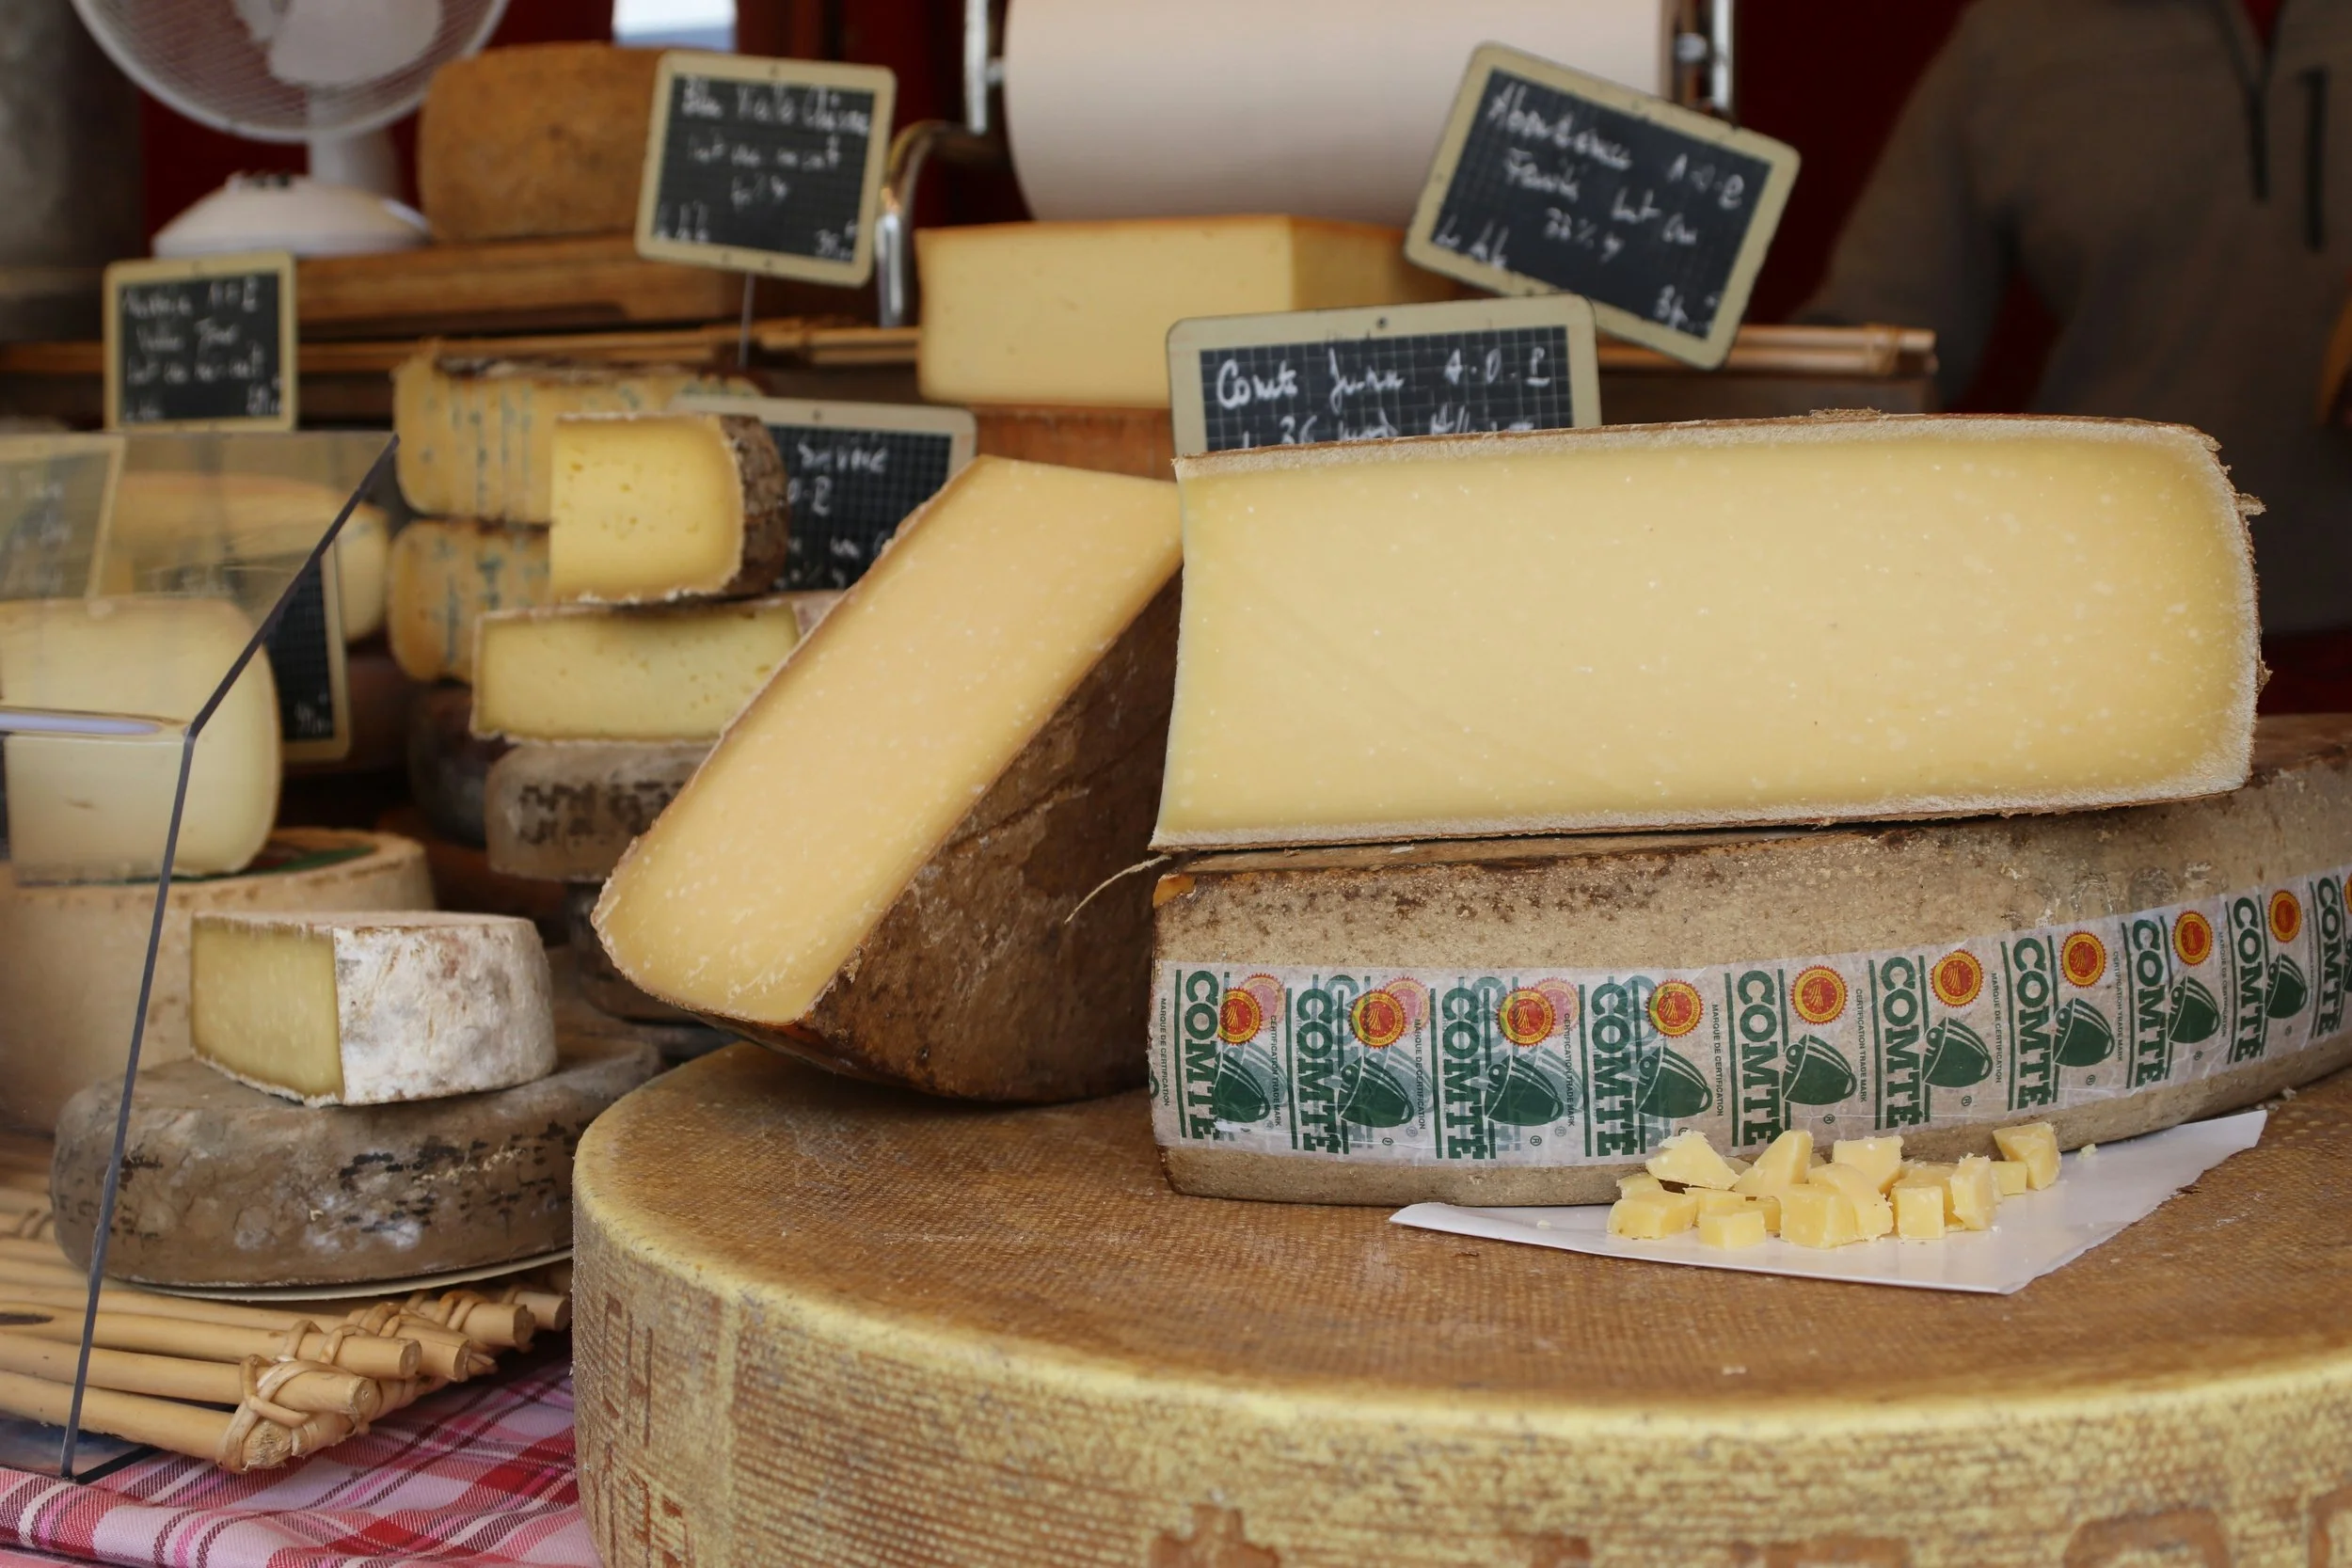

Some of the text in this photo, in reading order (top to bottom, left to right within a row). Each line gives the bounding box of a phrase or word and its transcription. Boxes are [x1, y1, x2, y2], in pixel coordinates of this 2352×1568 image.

[1991, 973, 2000, 1008] MARQUE
[1855, 989, 1866, 1050] CERTIFICATION
[1994, 1010, 2001, 1022] DE
[1564, 1013, 1573, 1073] CERTIFICATION
[1711, 1004, 1724, 1117] MARQUE DE CERTIFICATION
[1859, 1051, 1867, 1077] TRADE
[1566, 1104, 1575, 1127] MARK
